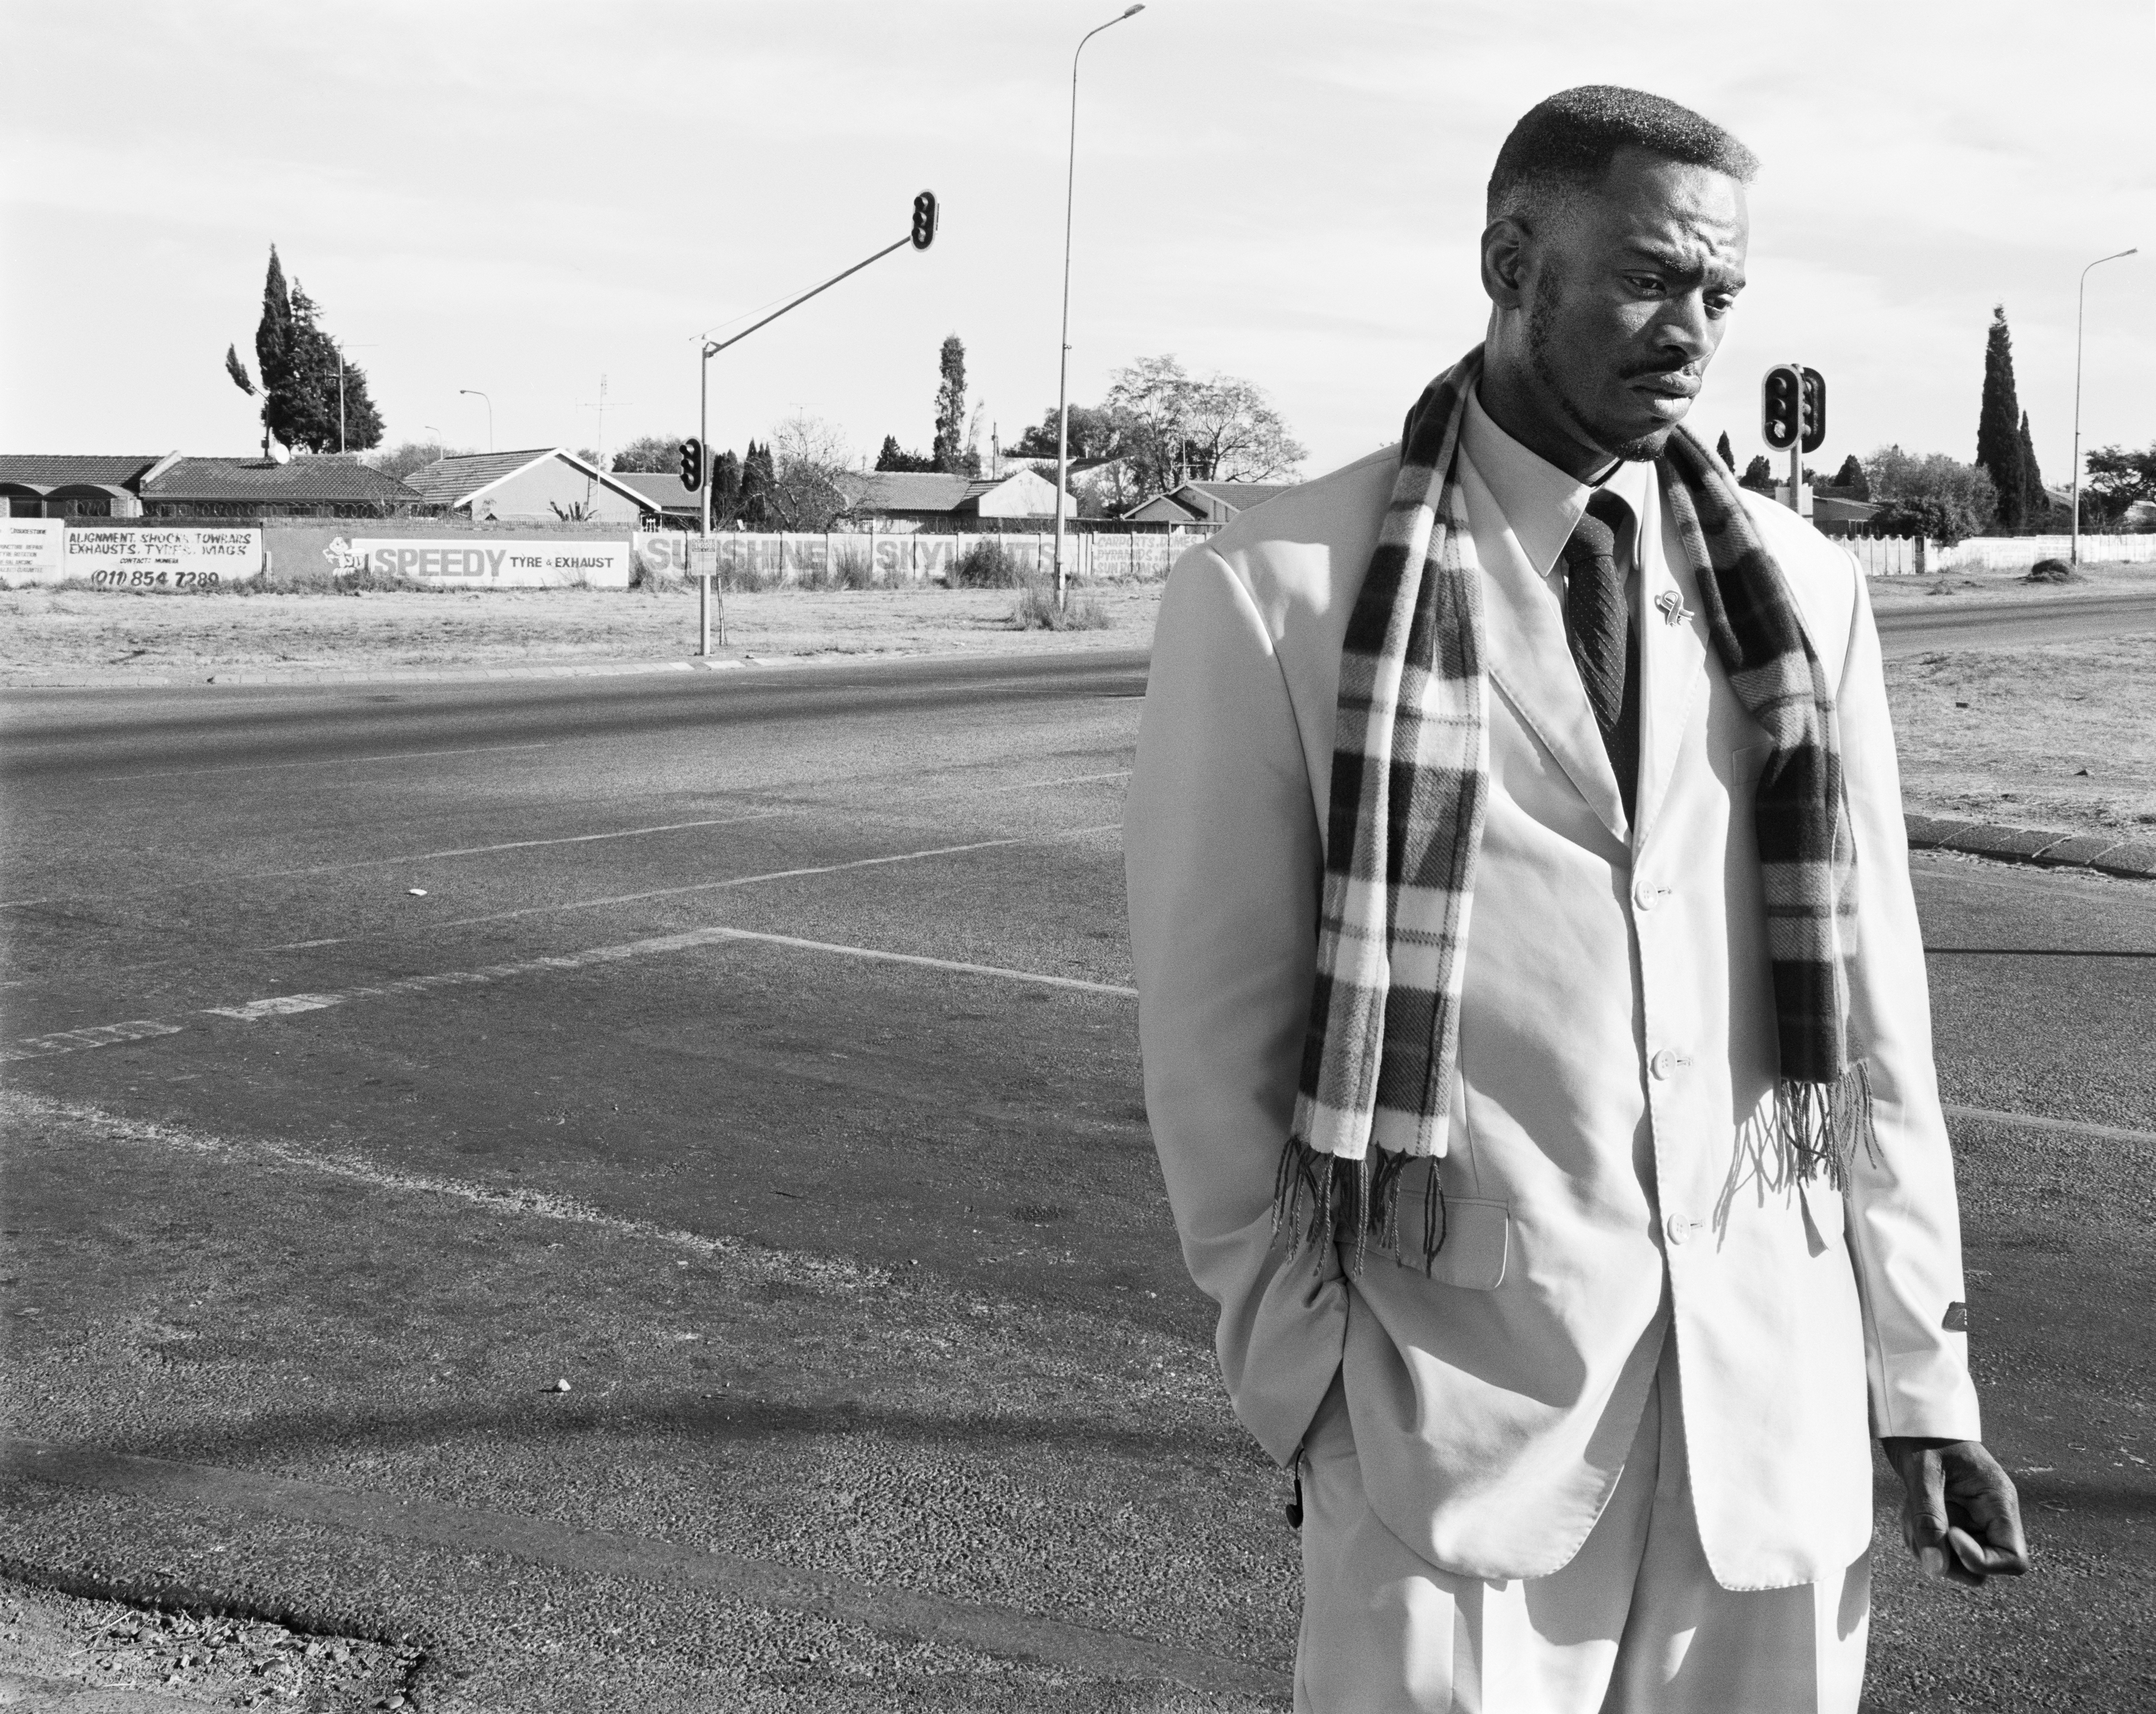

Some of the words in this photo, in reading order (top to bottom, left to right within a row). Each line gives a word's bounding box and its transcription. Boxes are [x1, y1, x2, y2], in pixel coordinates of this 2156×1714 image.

[202, 545, 246, 555] MAGS
[647, 538, 828, 571] SUSHINE
[375, 548, 507, 577] SPEEDY
[510, 557, 542, 567] TYRE
[555, 557, 614, 568] EXHAUST
[91, 570, 127, 586] (011)
[131, 571, 169, 586] 854
